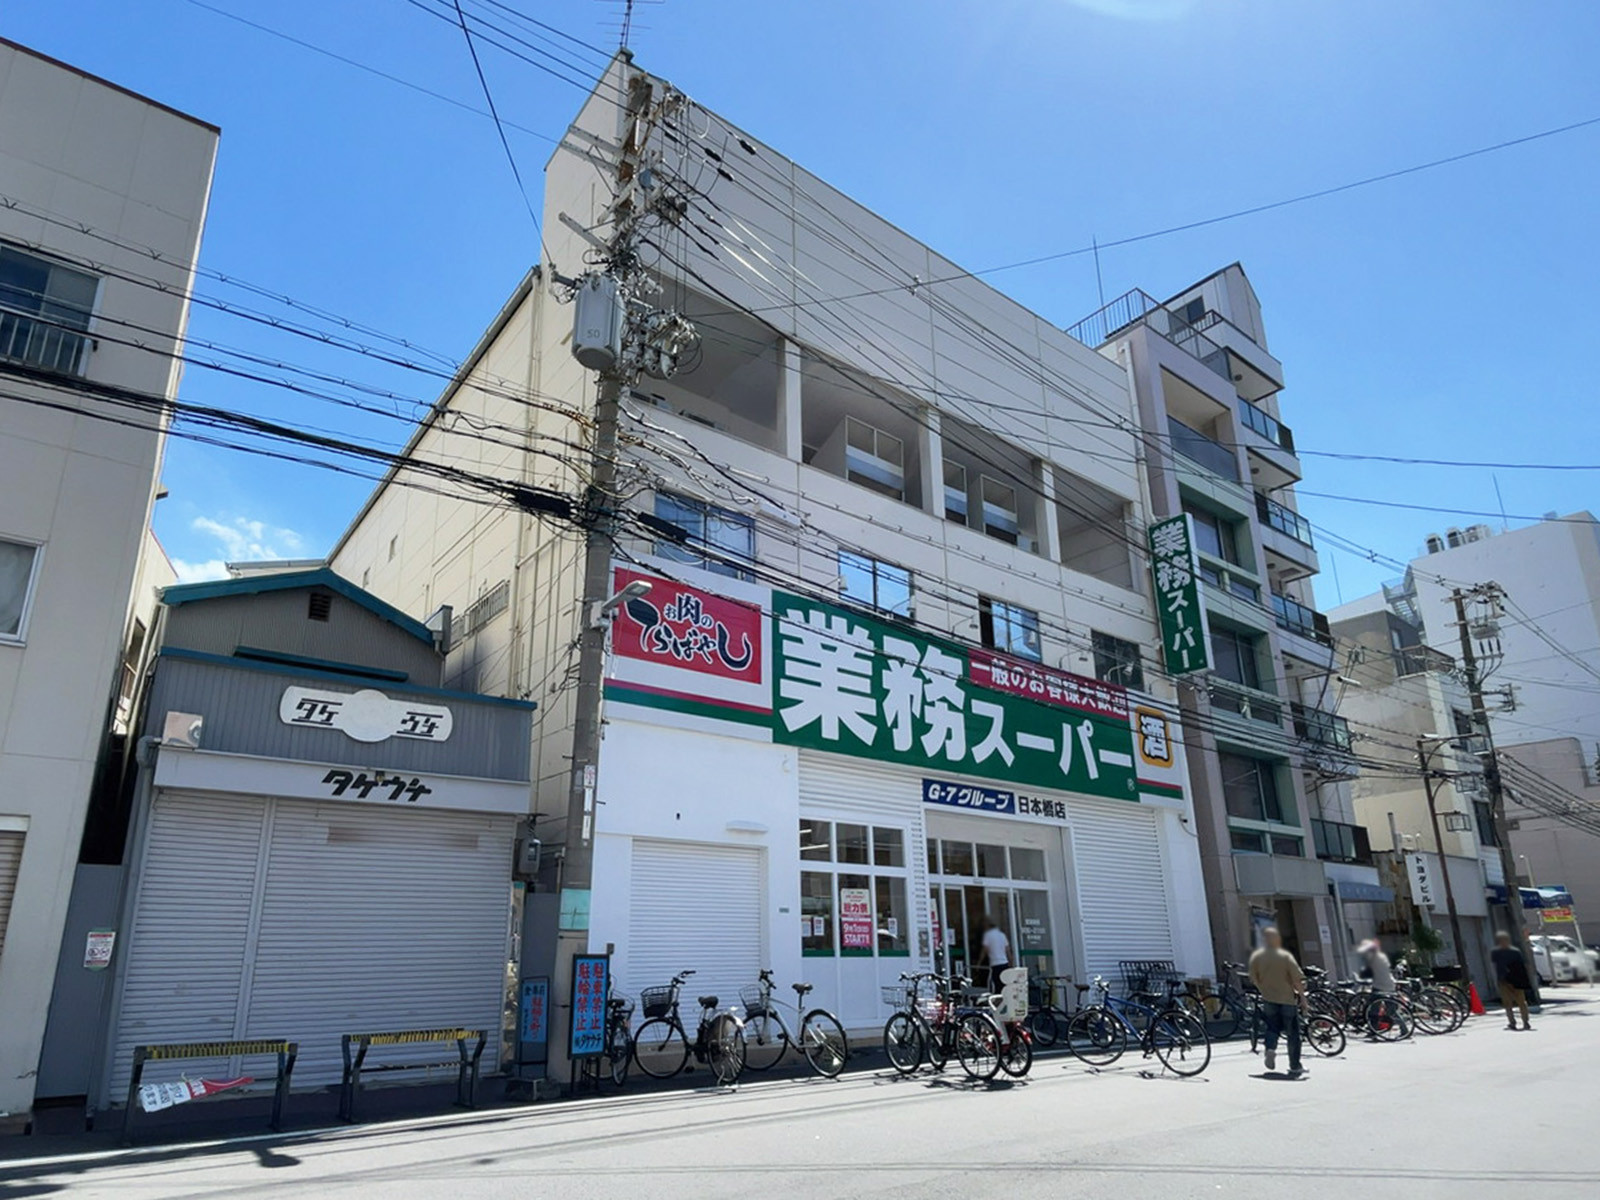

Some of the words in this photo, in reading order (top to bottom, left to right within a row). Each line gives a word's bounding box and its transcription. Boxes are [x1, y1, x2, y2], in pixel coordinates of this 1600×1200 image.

[587, 329, 600, 339] 50
[665, 593, 714, 630] お肉の
[1152, 520, 1196, 669] 業務スーパー
[778, 605, 1133, 780] 業務スーパー
[1140, 715, 1169, 761] 酒
[1018, 795, 1067, 820] 日本橋店
